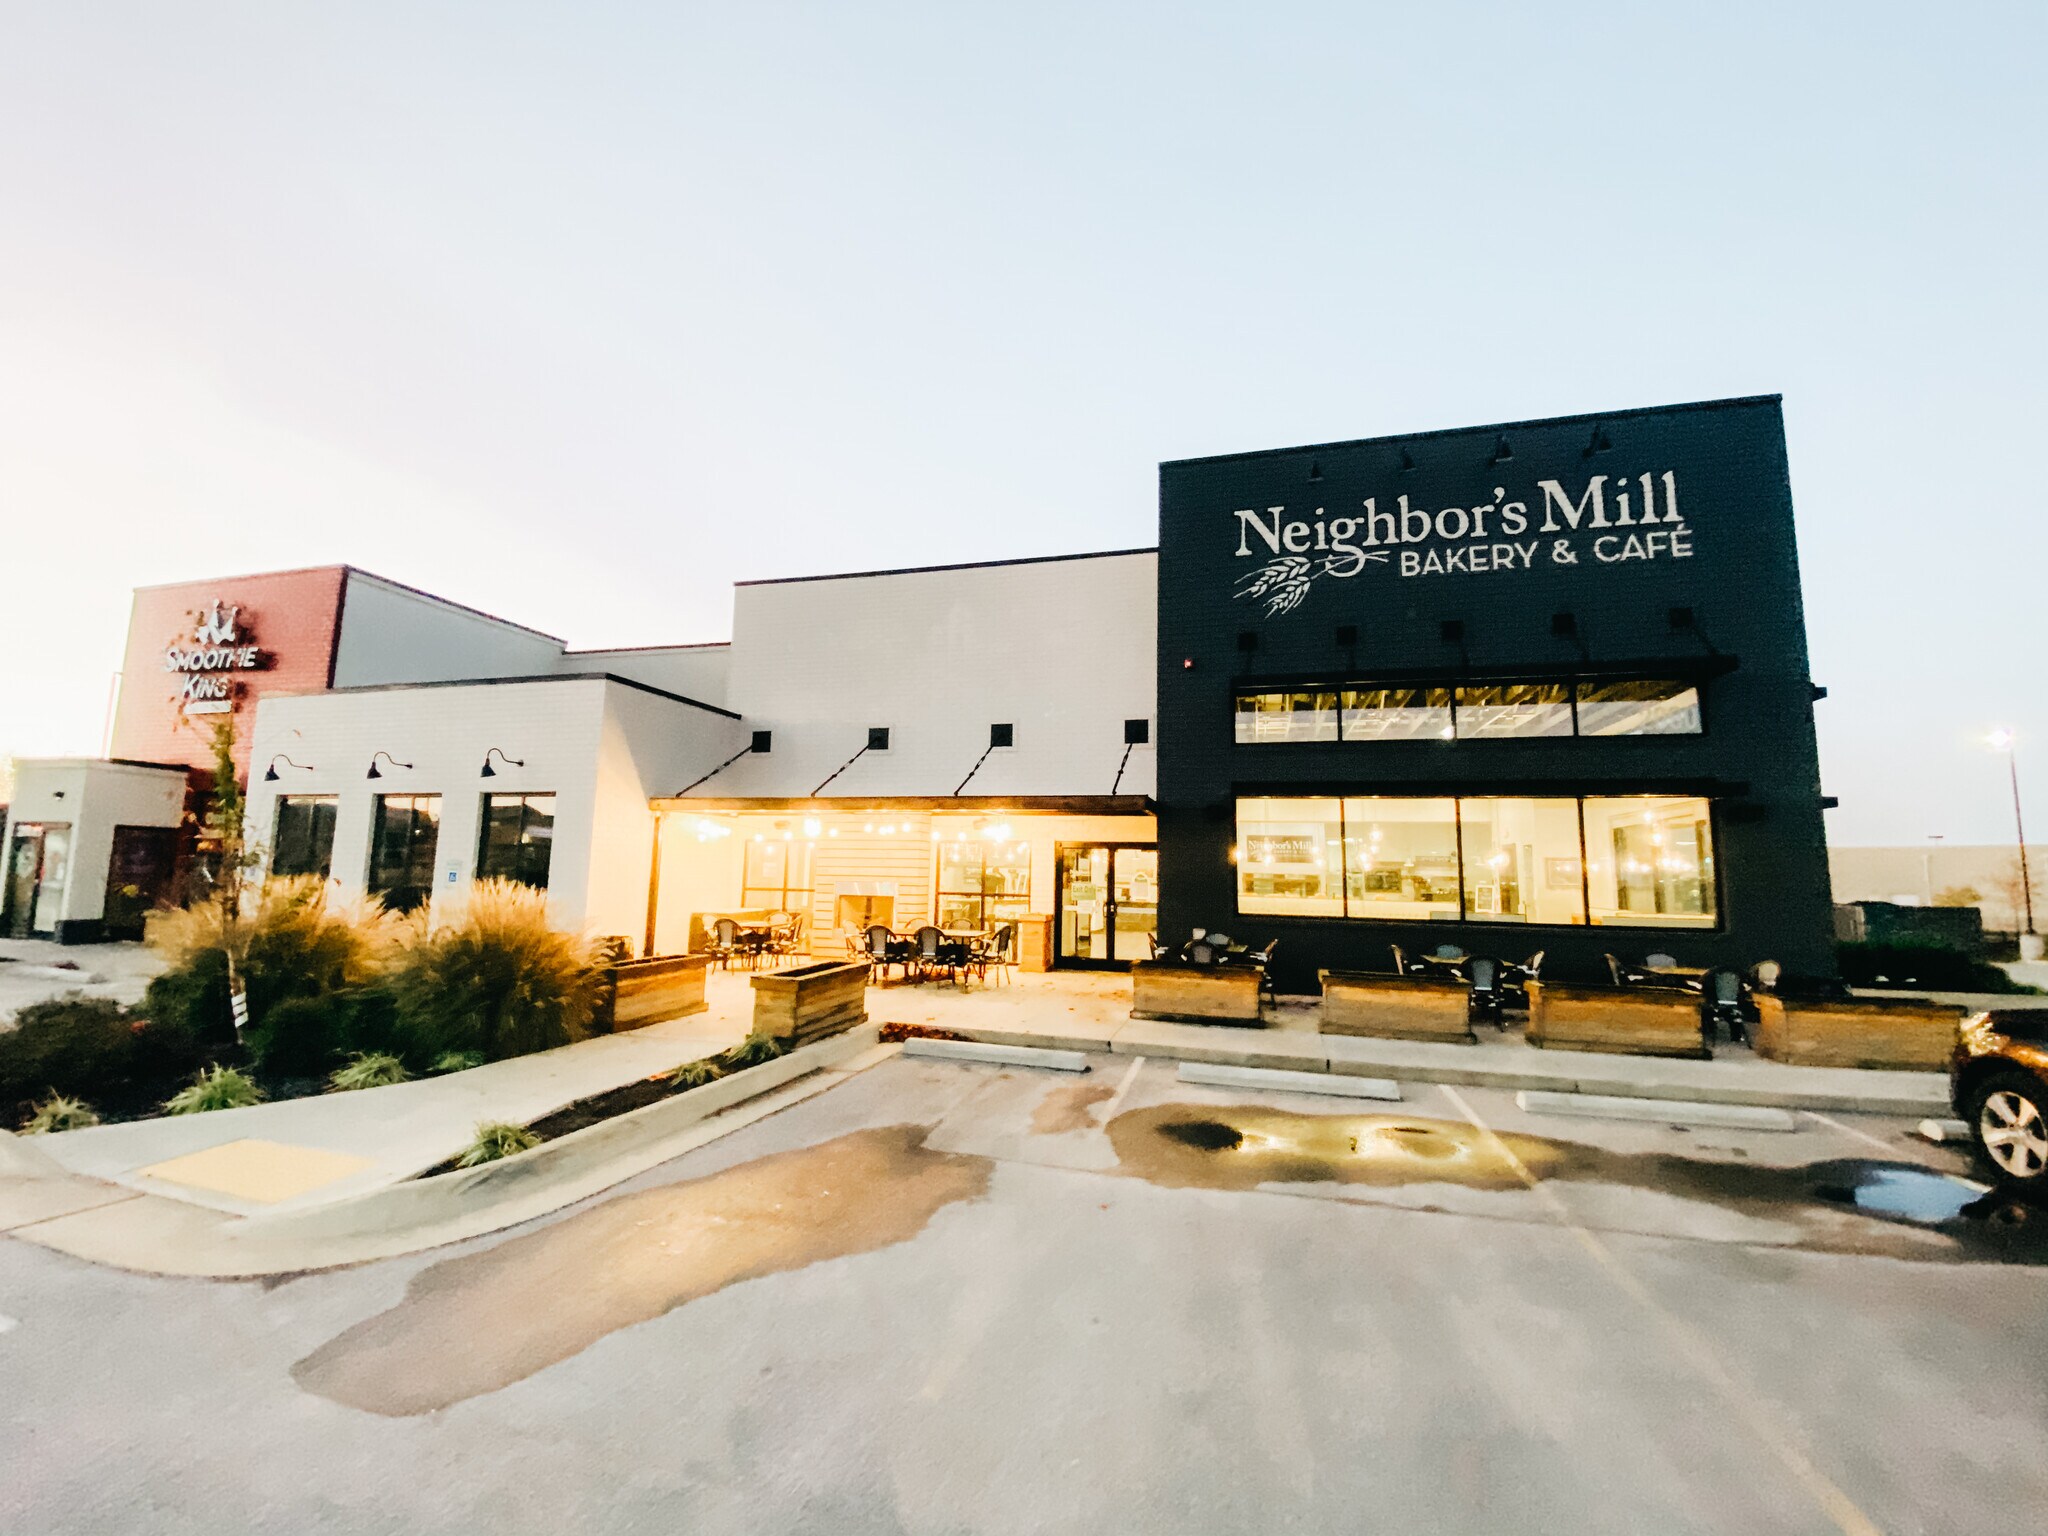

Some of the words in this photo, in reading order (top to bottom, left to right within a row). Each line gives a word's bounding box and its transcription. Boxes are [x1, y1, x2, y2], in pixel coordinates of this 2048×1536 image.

[1234, 487, 1528, 578] Neighbor's
[1538, 470, 1685, 533] Mill
[1400, 541, 1539, 577] BAKERY
[1552, 538, 1579, 564] &
[1593, 523, 1694, 563] CAFÉ
[1248, 839, 1291, 850] Nbor's
